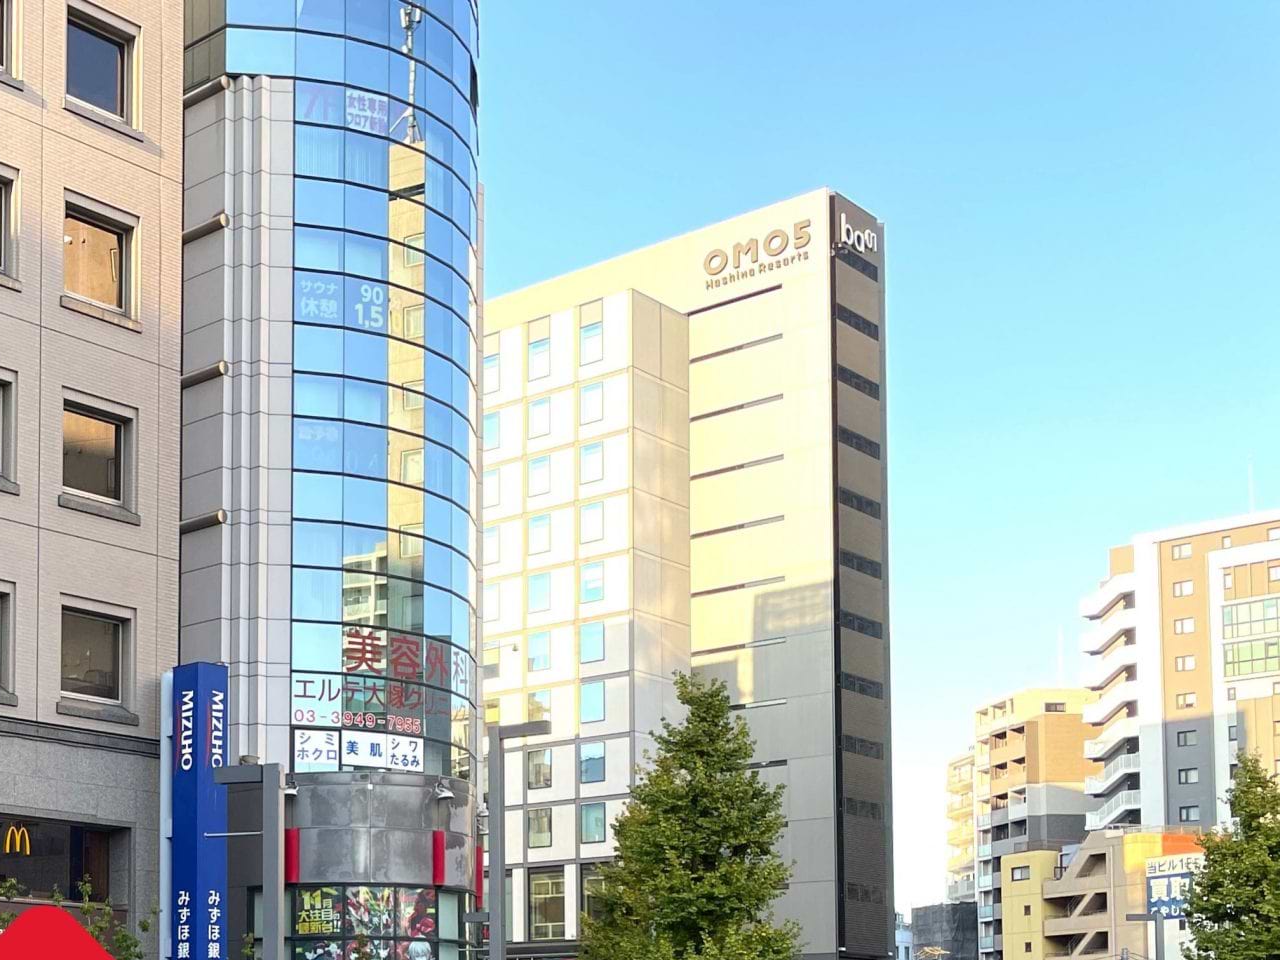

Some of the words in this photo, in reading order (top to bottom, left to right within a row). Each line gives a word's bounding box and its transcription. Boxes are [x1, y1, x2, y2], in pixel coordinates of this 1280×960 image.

[703, 219, 812, 276] OMO5
[706, 267, 755, 291] Hoshino
[758, 250, 809, 274] Resorts
[300, 279, 338, 294] サウナ
[360, 284, 384, 305] 90
[300, 296, 338, 319] 休憩
[345, 632, 469, 695] 美容外科
[181, 689, 195, 771] MIZUHO
[296, 747, 337, 762] ホクロ
[346, 740, 383, 759] 美肌
[390, 754, 420, 768] たるみ
